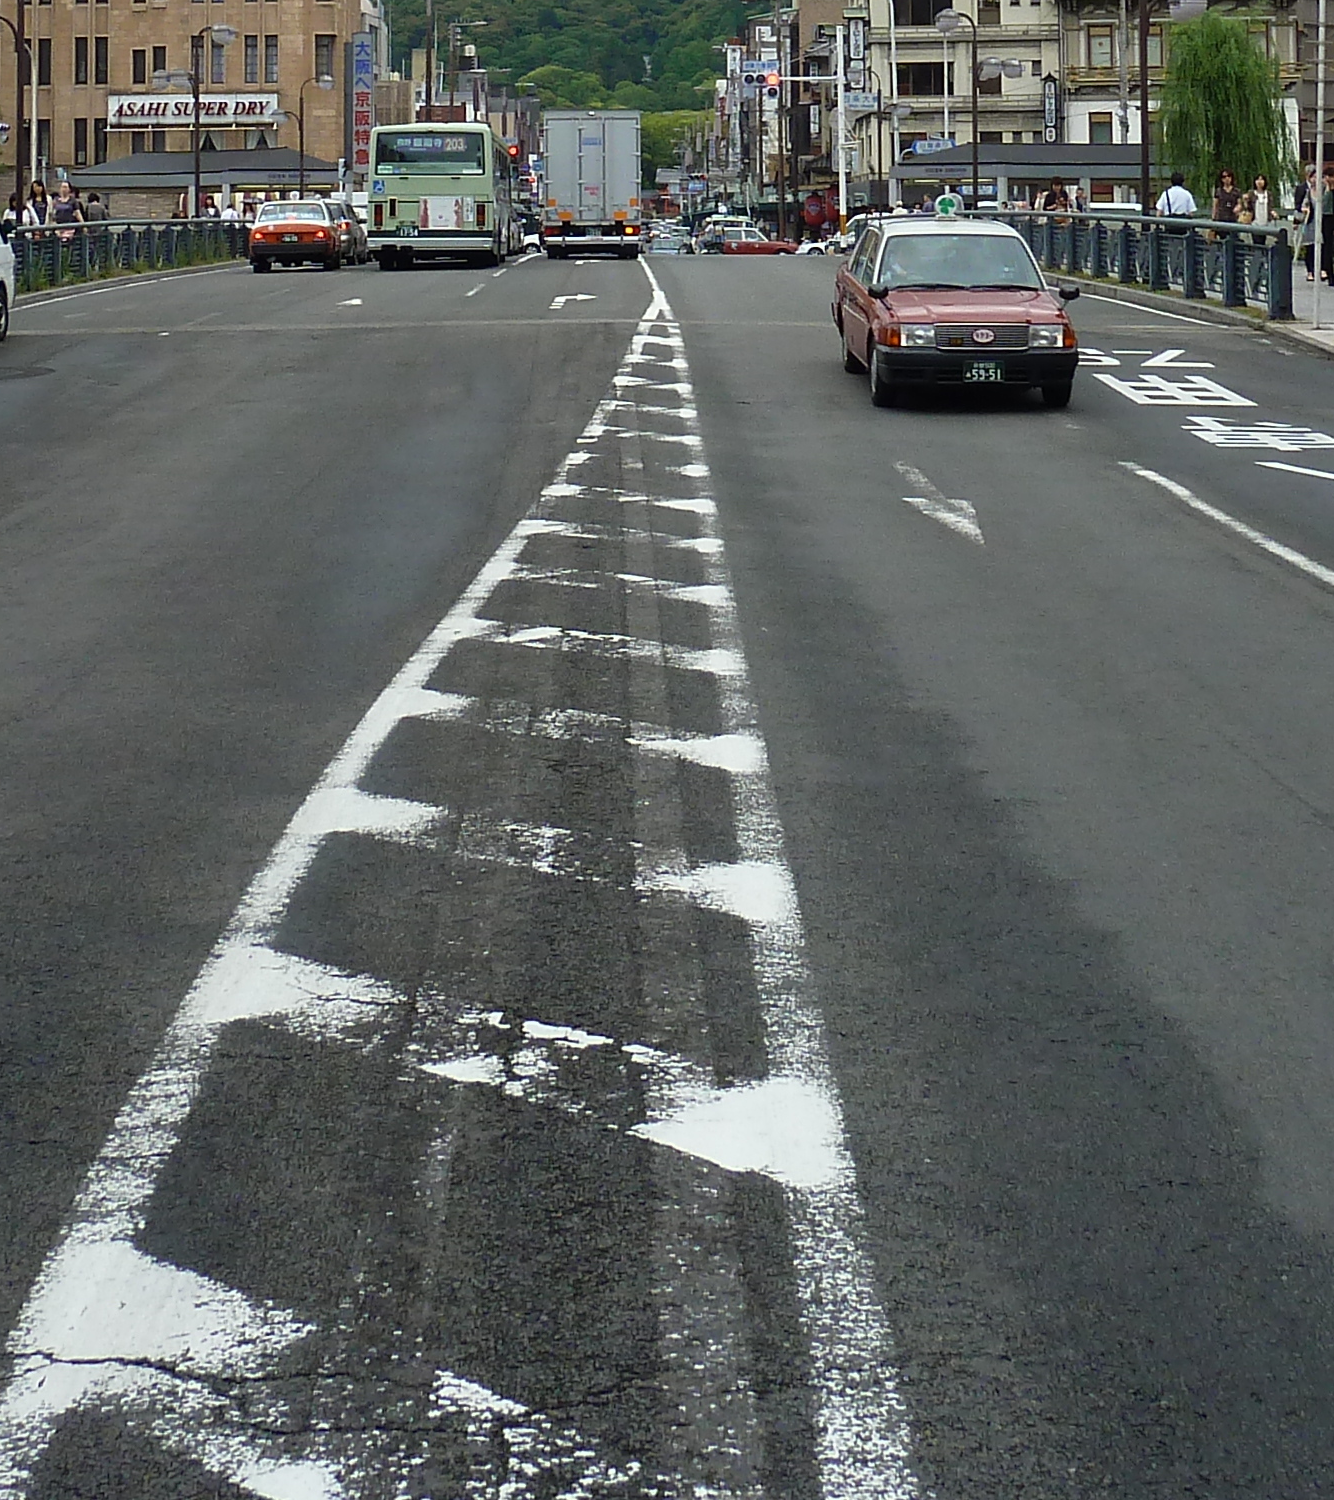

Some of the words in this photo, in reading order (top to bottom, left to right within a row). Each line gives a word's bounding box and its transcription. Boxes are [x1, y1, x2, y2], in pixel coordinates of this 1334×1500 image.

[112, 101, 168, 118] ASAHI
[171, 101, 229, 117] SUPER
[232, 100, 271, 116] DRY
[354, 40, 371, 166] 大阪へ京阪特急
[971, 368, 1001, 381] 59-51
